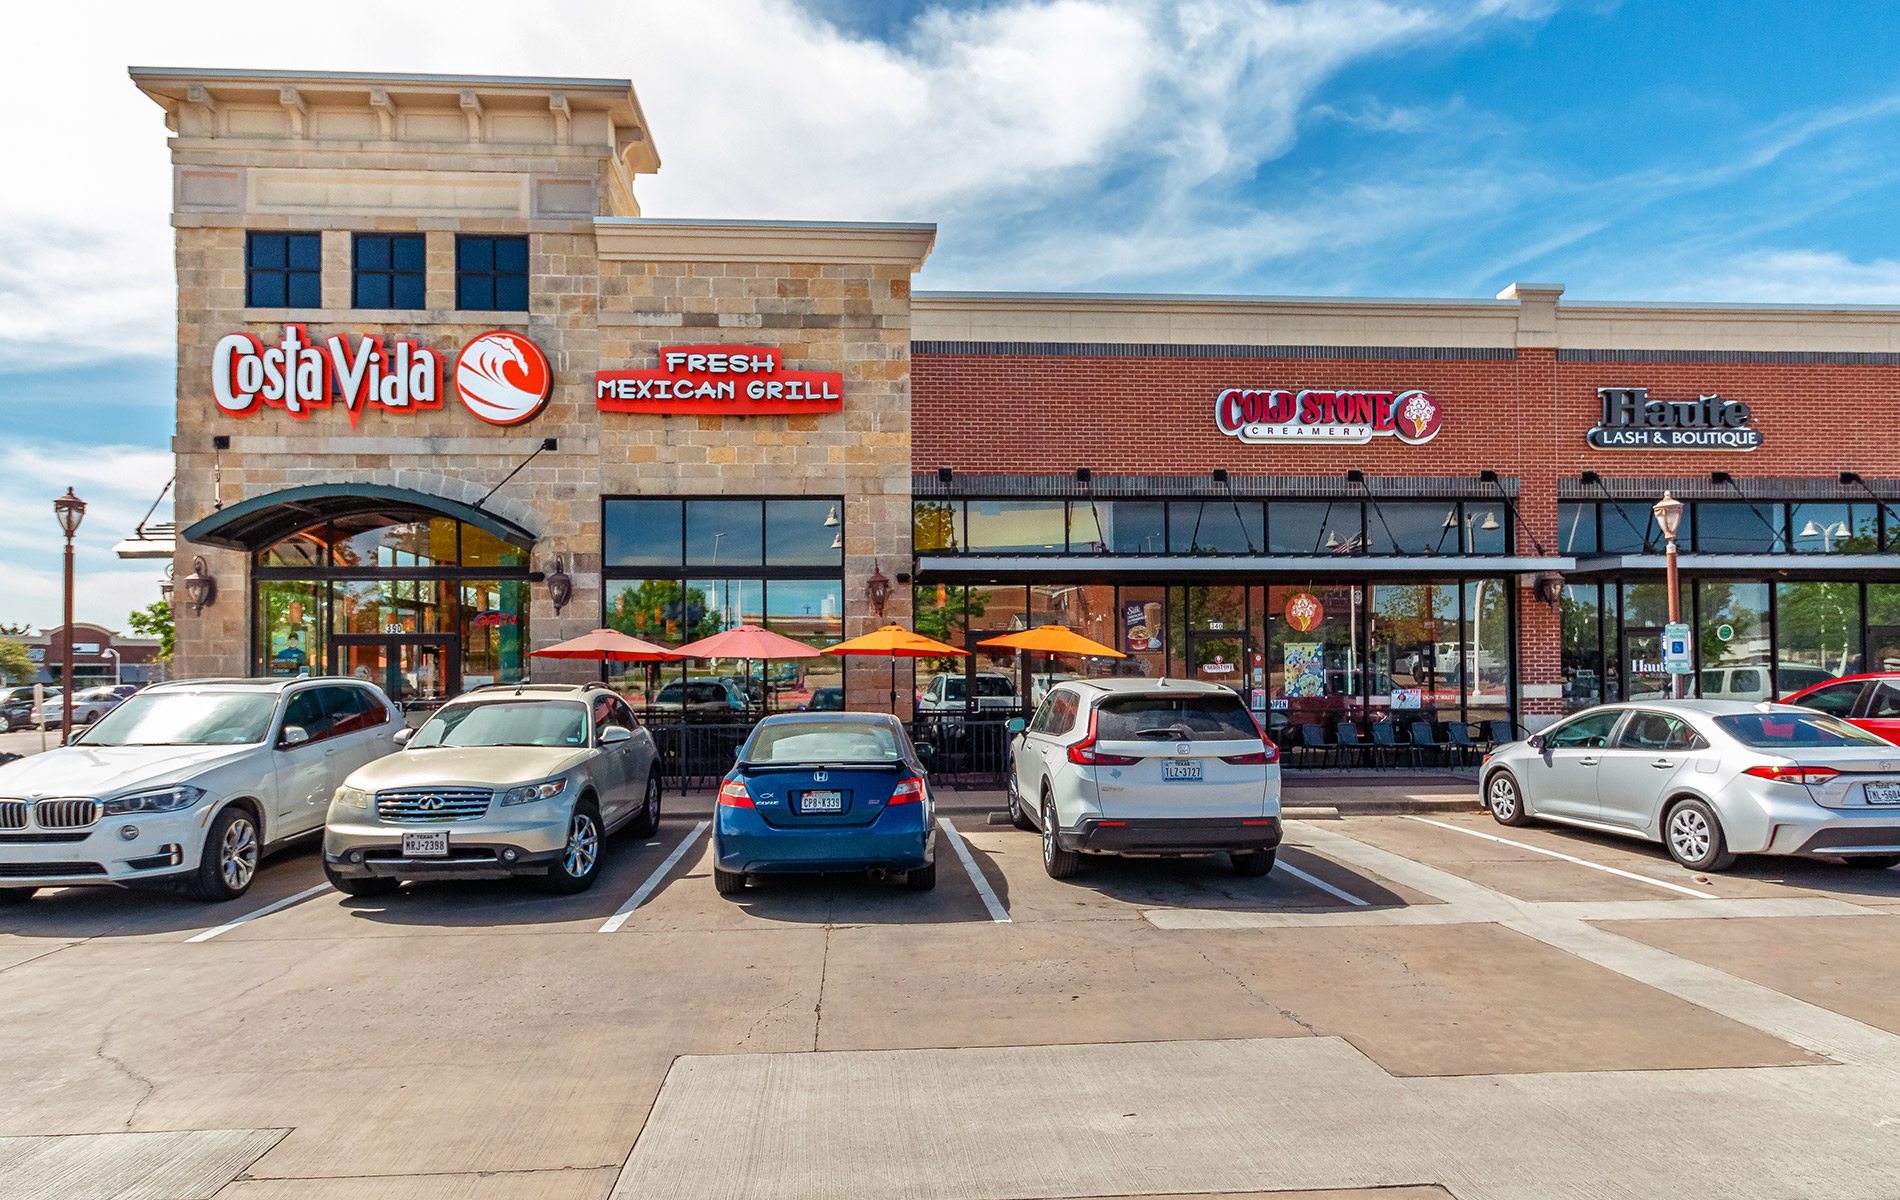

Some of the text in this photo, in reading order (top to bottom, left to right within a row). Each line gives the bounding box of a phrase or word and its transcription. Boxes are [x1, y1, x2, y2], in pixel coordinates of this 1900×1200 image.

[211, 325, 435, 412] Costa Vida
[665, 352, 775, 374] FRESH
[597, 378, 840, 401] MEXICAN GRILL
[1222, 390, 1396, 431] COLD STONE
[1599, 387, 1751, 428] Haute
[1251, 426, 1366, 437] CREAMERY
[1603, 431, 1758, 448] LASH & BOUTIQUE
[386, 624, 402, 634] 390
[476, 613, 518, 627] OPEN
[1631, 659, 1667, 673] Haut
